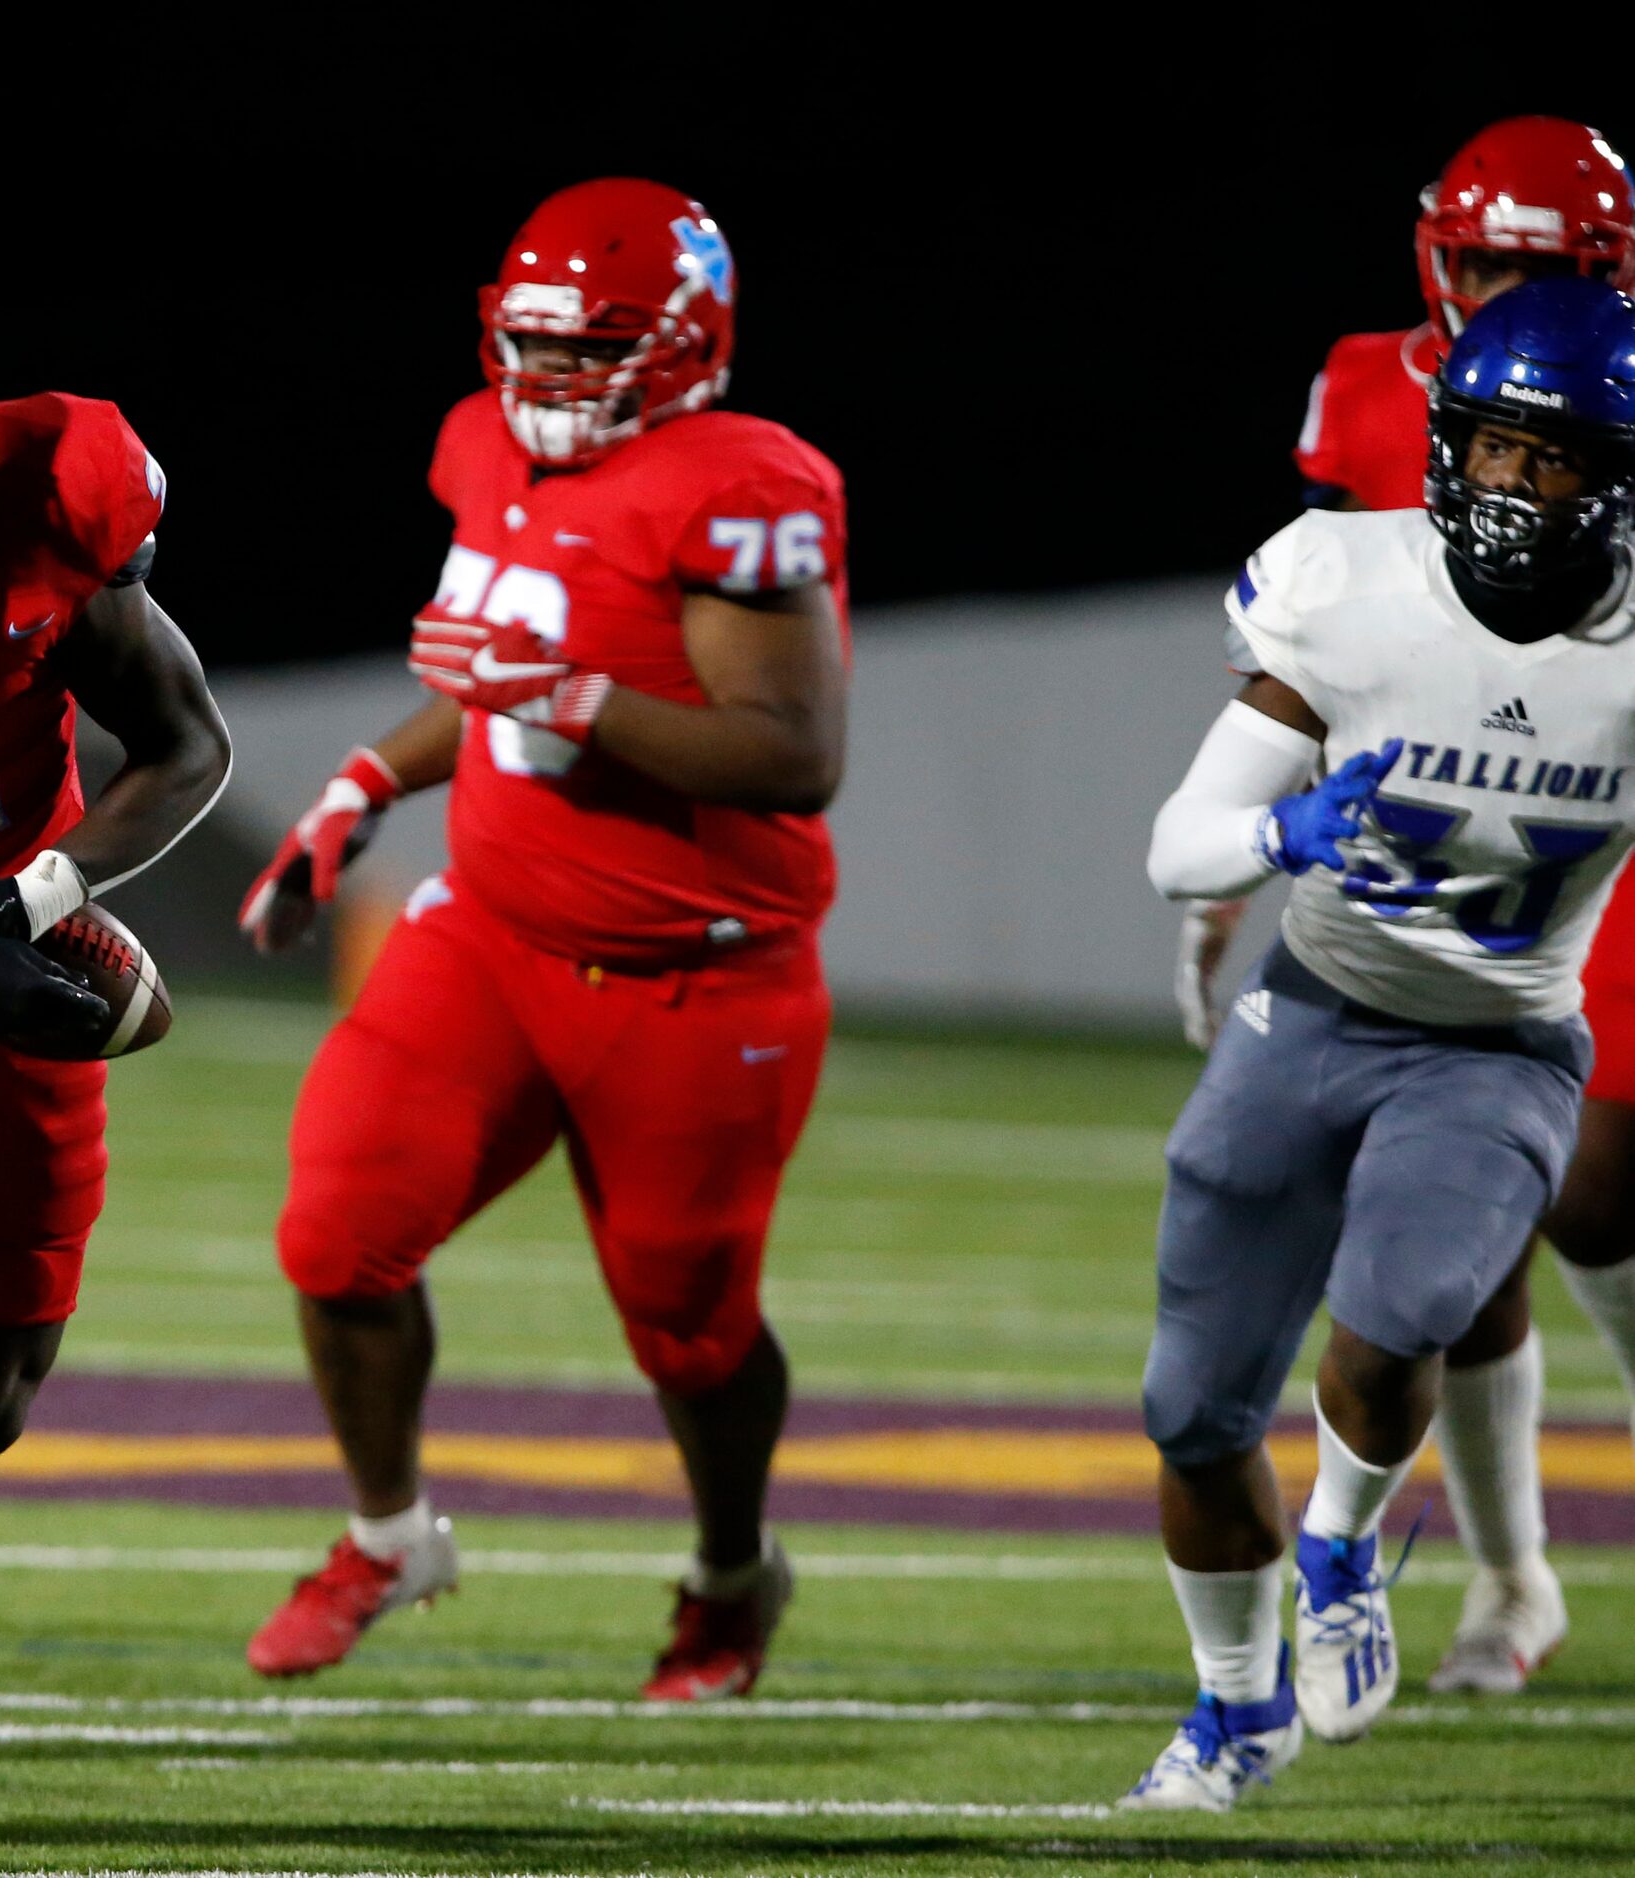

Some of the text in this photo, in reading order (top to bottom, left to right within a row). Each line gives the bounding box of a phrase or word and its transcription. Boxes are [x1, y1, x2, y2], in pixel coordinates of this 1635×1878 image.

[1500, 382, 1564, 410] Riddell
[708, 511, 826, 593] 76
[1480, 715, 1537, 738] adidas
[1405, 740, 1626, 803] TALLIONS
